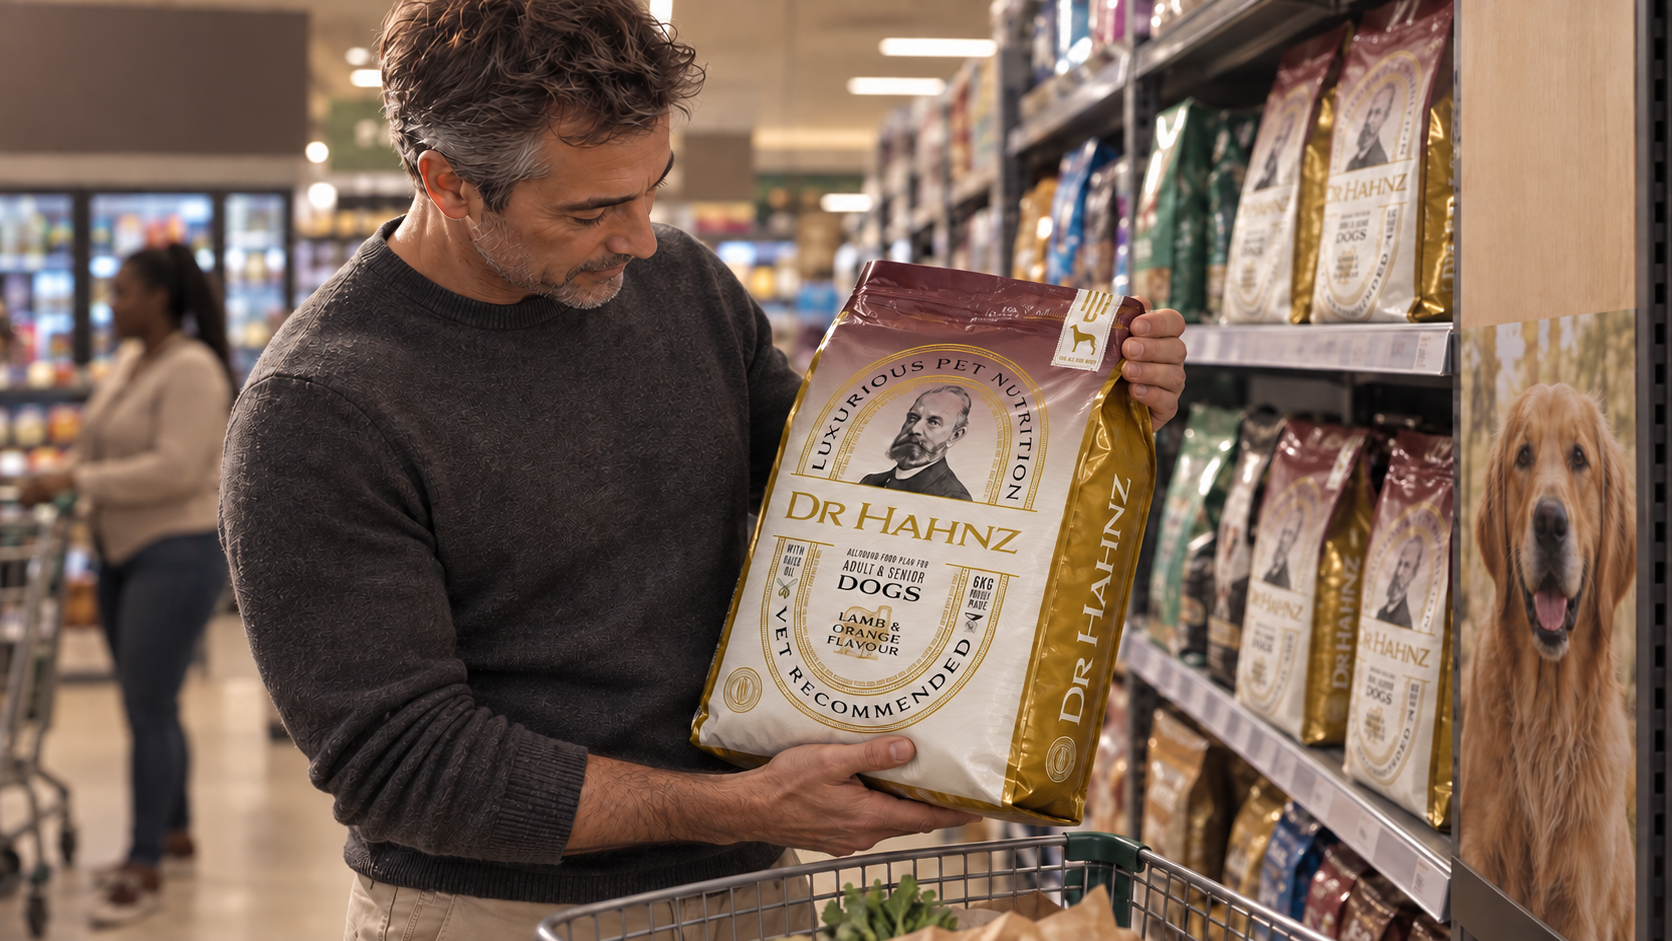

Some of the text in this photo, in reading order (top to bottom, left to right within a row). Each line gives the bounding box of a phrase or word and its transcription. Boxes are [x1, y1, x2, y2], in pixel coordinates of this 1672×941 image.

[1344, 173, 1408, 202] HAHNZ
[1336, 228, 1368, 244] DOGS
[811, 358, 1033, 501] LUXURIOUS PET NUTRITION
[785, 491, 1022, 555] DR HAHNZ
[786, 544, 805, 556] WITH
[842, 560, 926, 584] ADULT & SENIOR
[973, 575, 994, 591] 6KG
[837, 574, 922, 602] DOGS
[1059, 473, 1132, 726] DR HAHNZ
[1335, 554, 1361, 651] HAHNZ
[832, 623, 901, 645] ORANGE
[839, 612, 901, 632] LAMB &
[826, 635, 900, 657] FLAVOUR
[1373, 631, 1431, 669] HAHNZ
[775, 605, 971, 719] VET RECOMMENDED
[1366, 684, 1393, 706] DOGS
